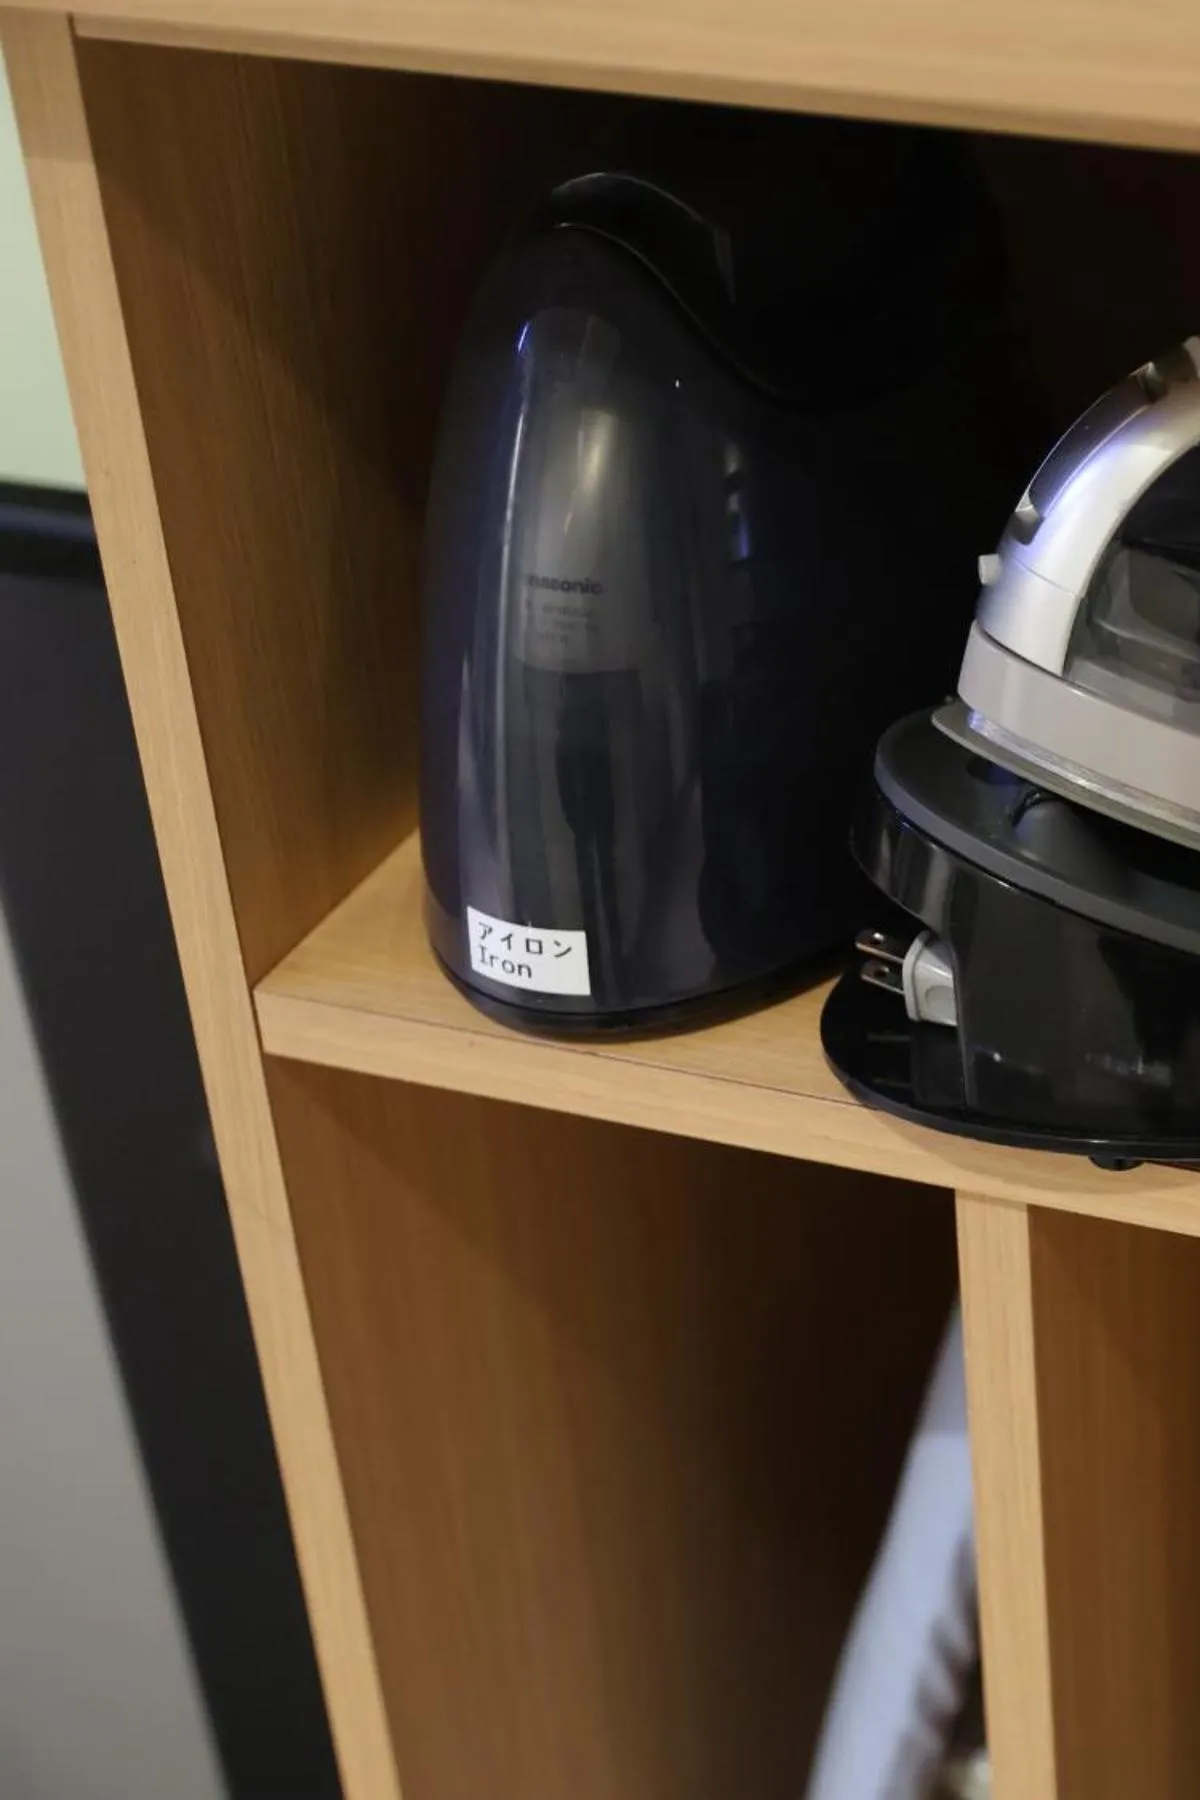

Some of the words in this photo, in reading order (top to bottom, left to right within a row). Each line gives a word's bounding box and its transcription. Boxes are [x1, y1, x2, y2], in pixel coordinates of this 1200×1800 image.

[478, 922, 572, 958] アイロン
[478, 944, 533, 979] Iron
